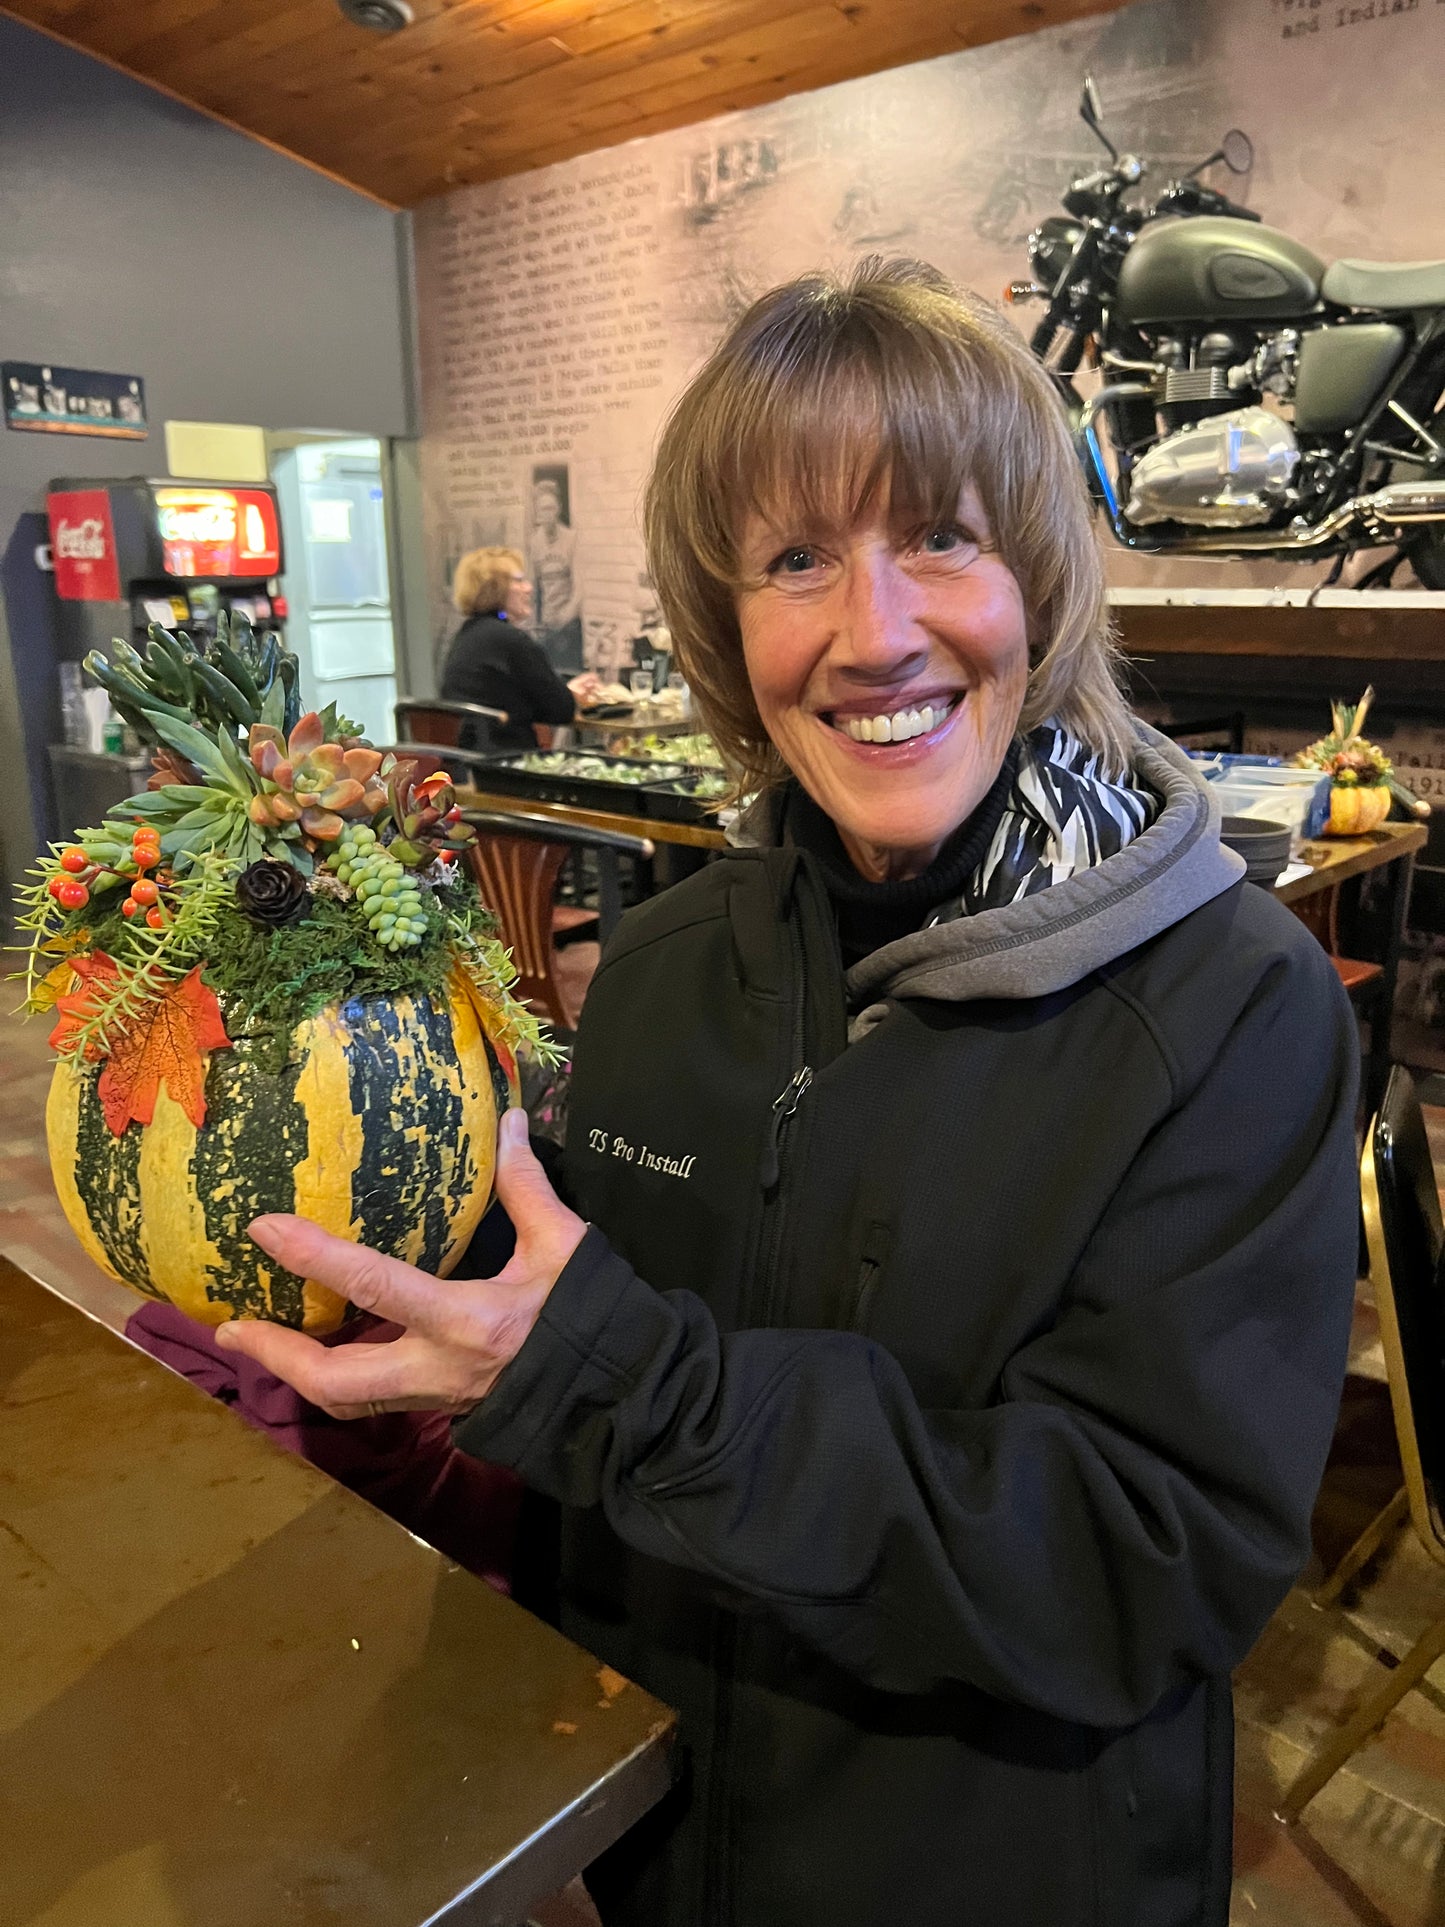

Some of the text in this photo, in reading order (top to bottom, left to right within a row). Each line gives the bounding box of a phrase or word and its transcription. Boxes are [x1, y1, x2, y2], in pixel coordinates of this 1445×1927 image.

[589, 1128, 697, 1179] TS Pro Install
